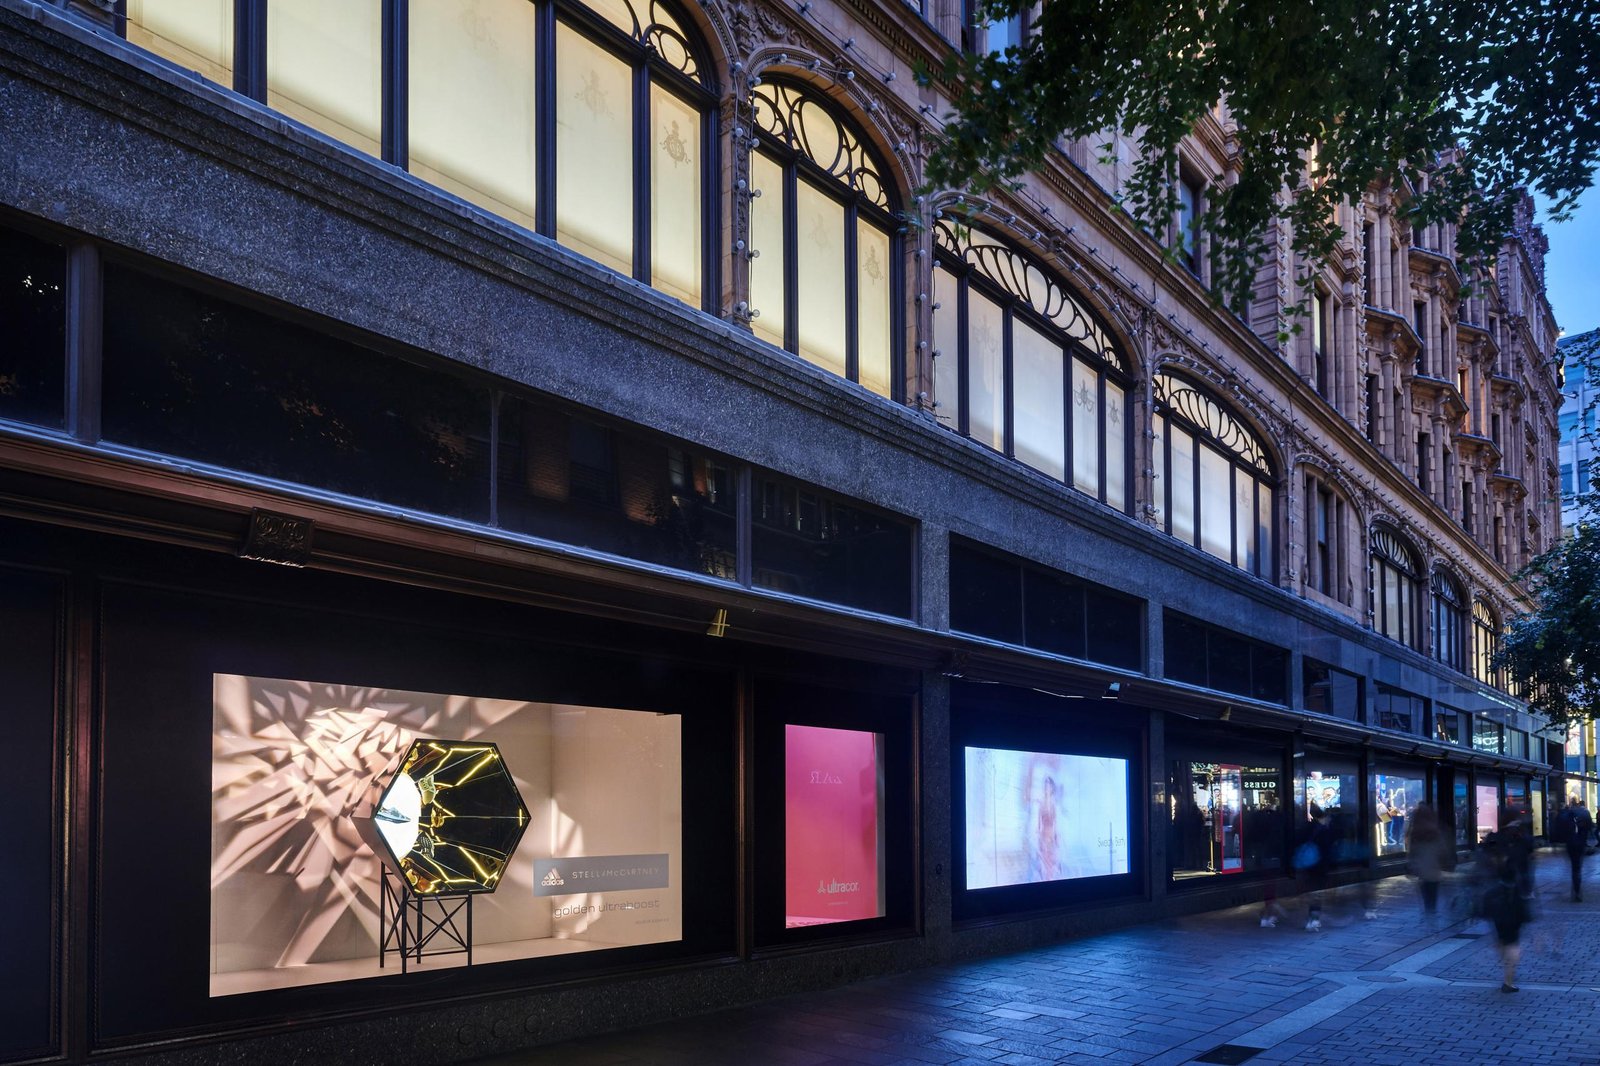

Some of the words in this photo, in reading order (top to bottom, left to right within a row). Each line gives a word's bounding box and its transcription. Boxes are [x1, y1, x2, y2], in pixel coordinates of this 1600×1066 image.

[541, 878, 565, 887] adidas
[554, 904, 595, 919] golden
[599, 899, 660, 912] ultraboost
